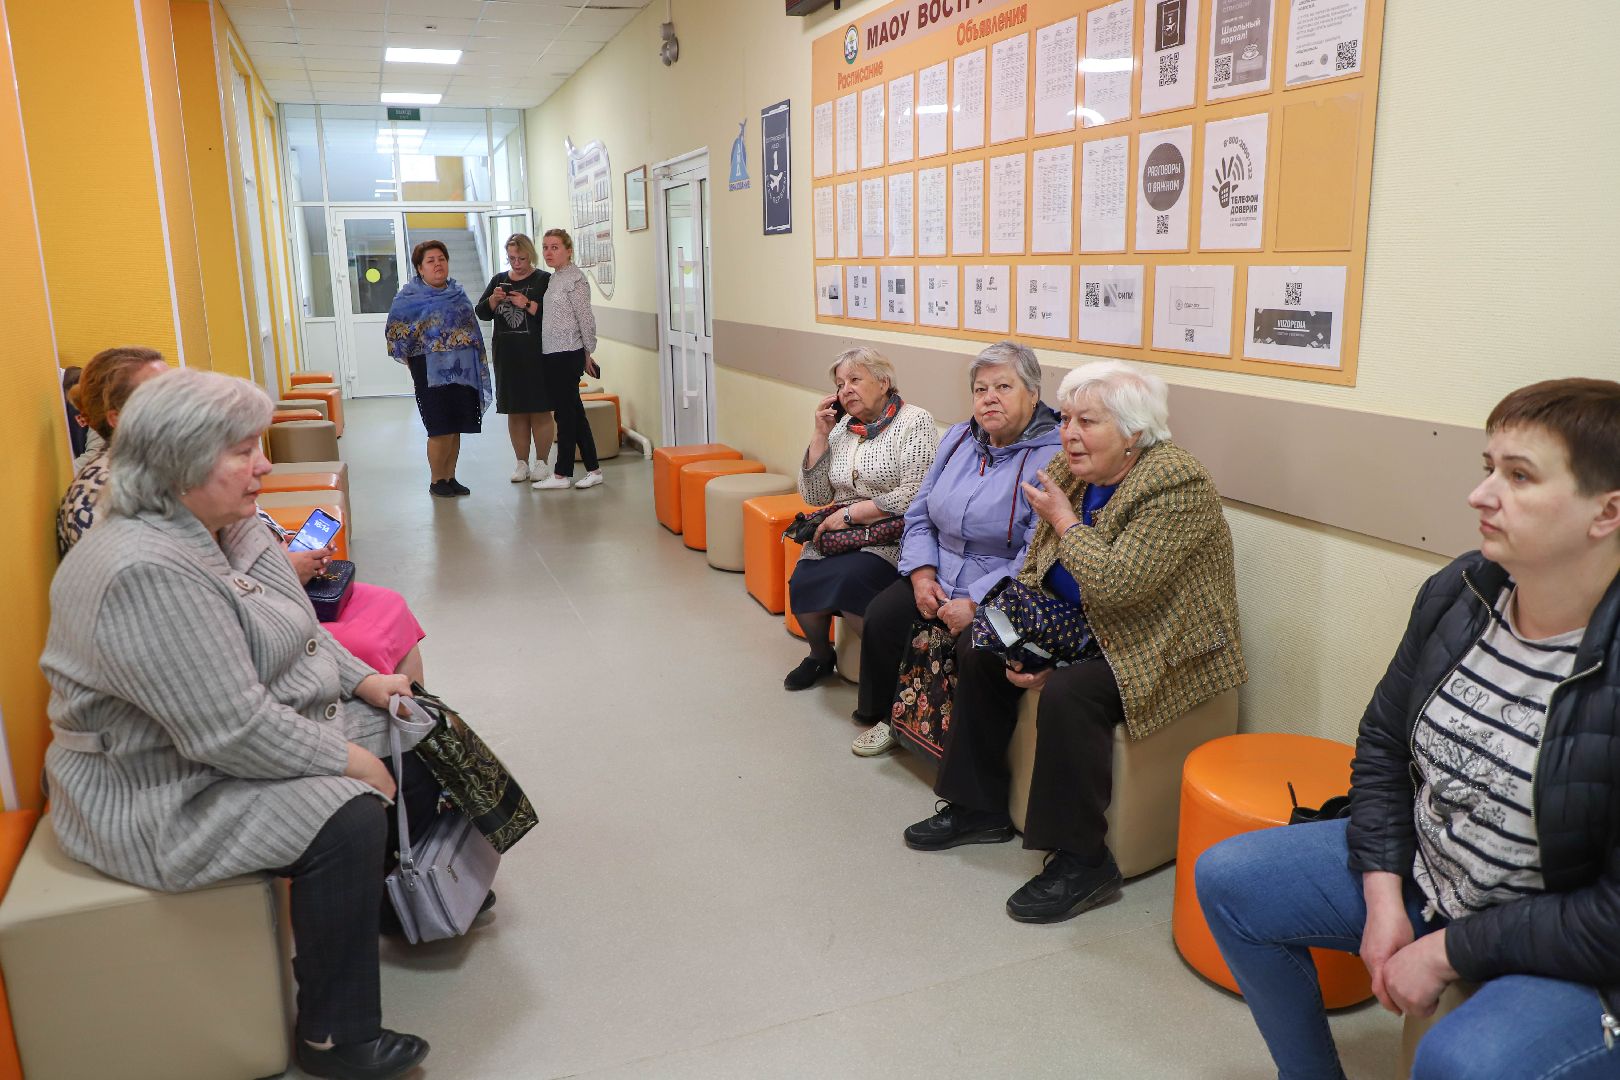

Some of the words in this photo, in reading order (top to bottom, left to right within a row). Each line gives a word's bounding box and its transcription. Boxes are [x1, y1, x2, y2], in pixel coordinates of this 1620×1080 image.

[867, 10, 910, 50] МАОУ
[917, 0, 983, 29] ВОС
[956, 4, 1028, 46] Объявления
[1221, 17, 1261, 35] Школьный
[1220, 29, 1248, 45] портал!
[837, 60, 883, 91] Расписание
[1147, 162, 1181, 177] РАЗГОВОРЫ
[1147, 182, 1152, 193] О
[1152, 179, 1180, 193] ВАЖНОМ
[1230, 194, 1259, 205] ТЕЛЕФОН
[1230, 204, 1258, 215] ДОВЕРИЯ
[1277, 319, 1306, 329] VUZOPEDIA
